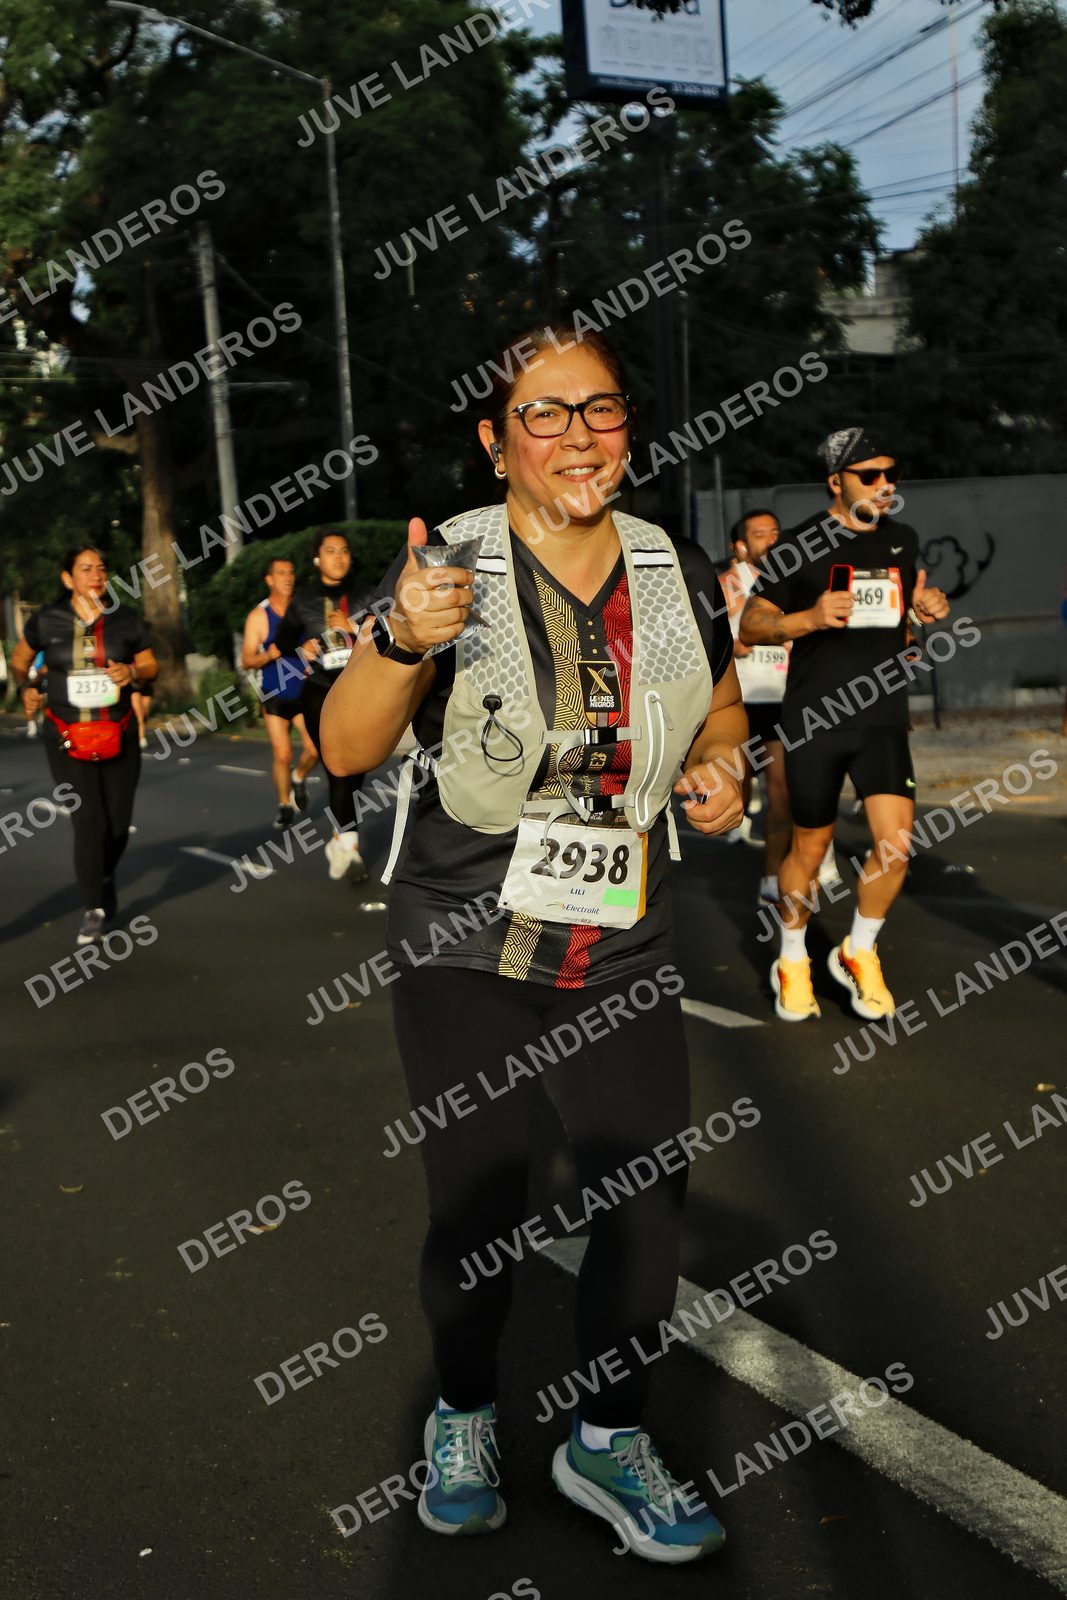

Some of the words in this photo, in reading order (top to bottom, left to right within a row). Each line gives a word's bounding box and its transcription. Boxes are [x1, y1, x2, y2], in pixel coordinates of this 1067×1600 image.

[76, 680, 108, 694] 2375
[530, 838, 630, 885] 2938
[570, 888, 586, 896] LILI
